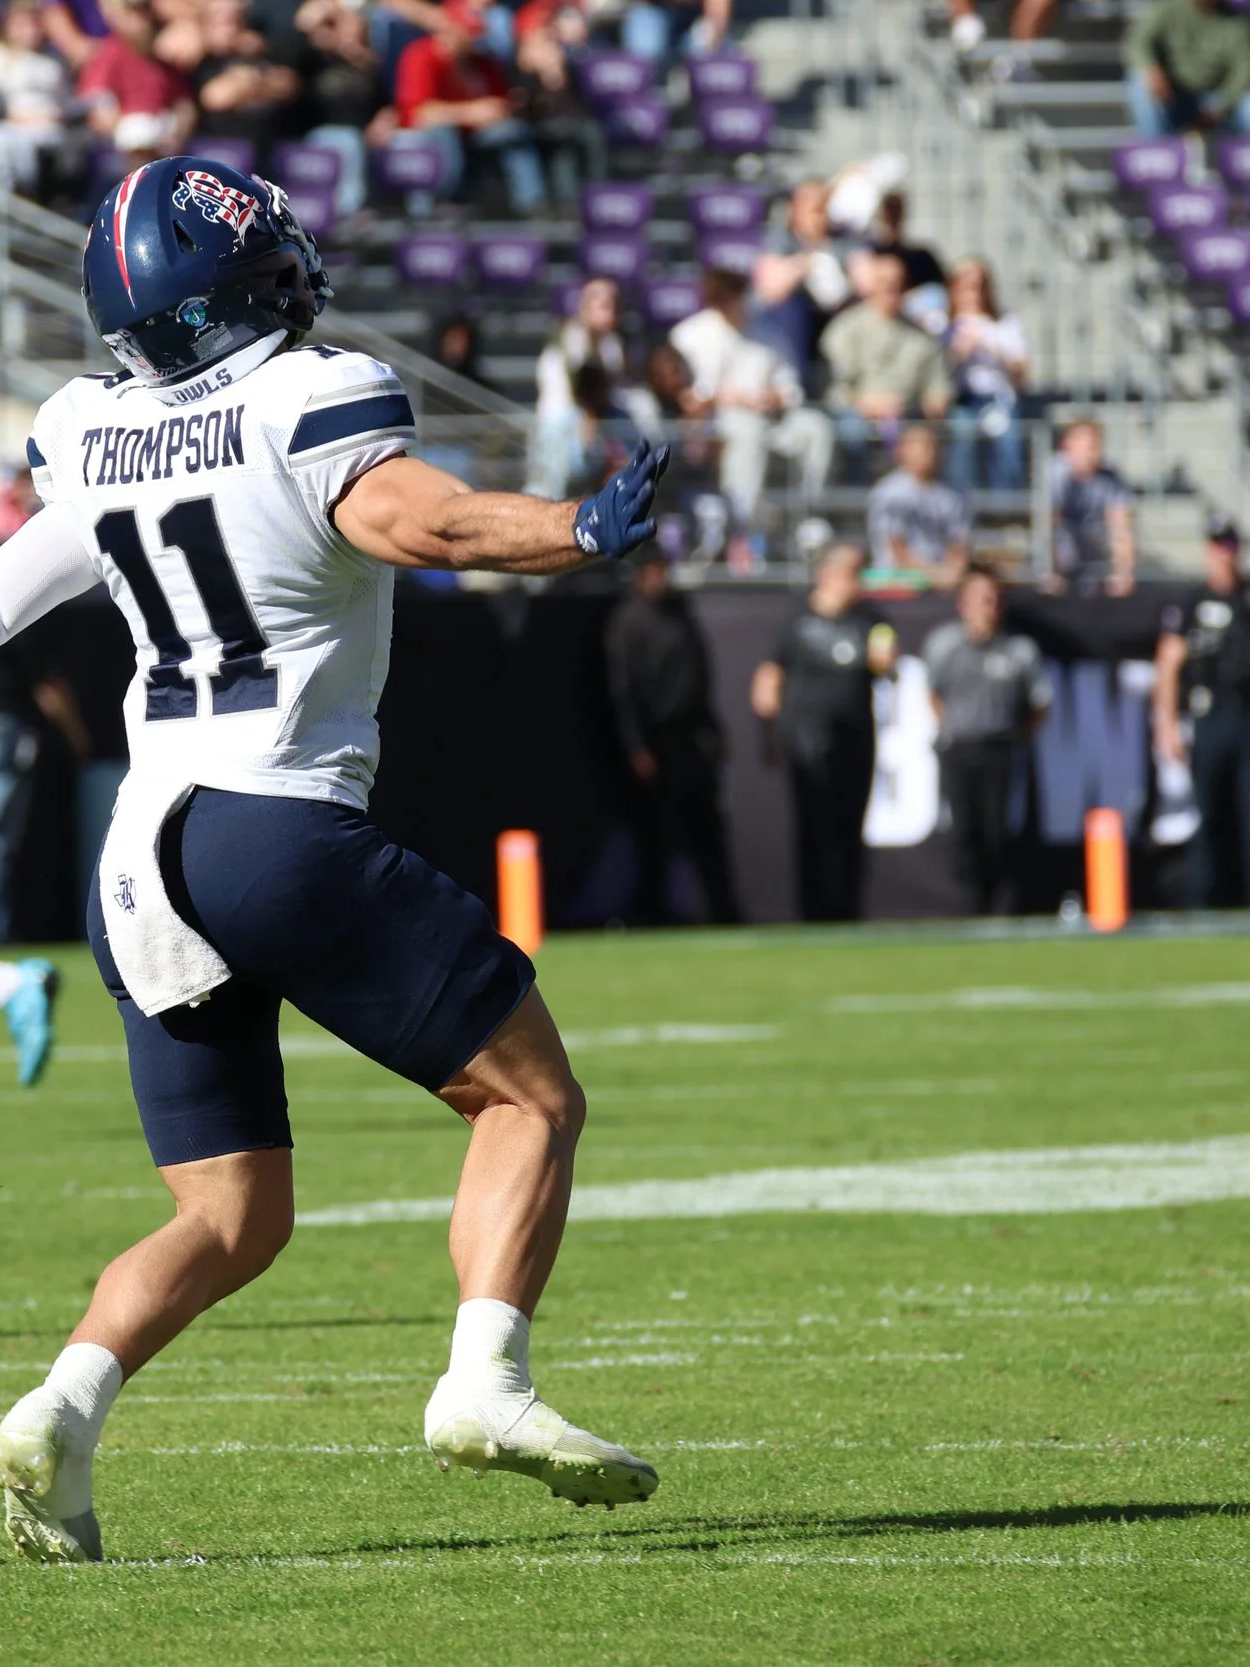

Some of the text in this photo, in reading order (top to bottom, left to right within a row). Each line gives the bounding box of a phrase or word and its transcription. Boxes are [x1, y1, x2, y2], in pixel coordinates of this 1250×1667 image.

[171, 367, 233, 404] OWLS
[81, 404, 246, 488] THOMPSON
[93, 493, 283, 725] 11
